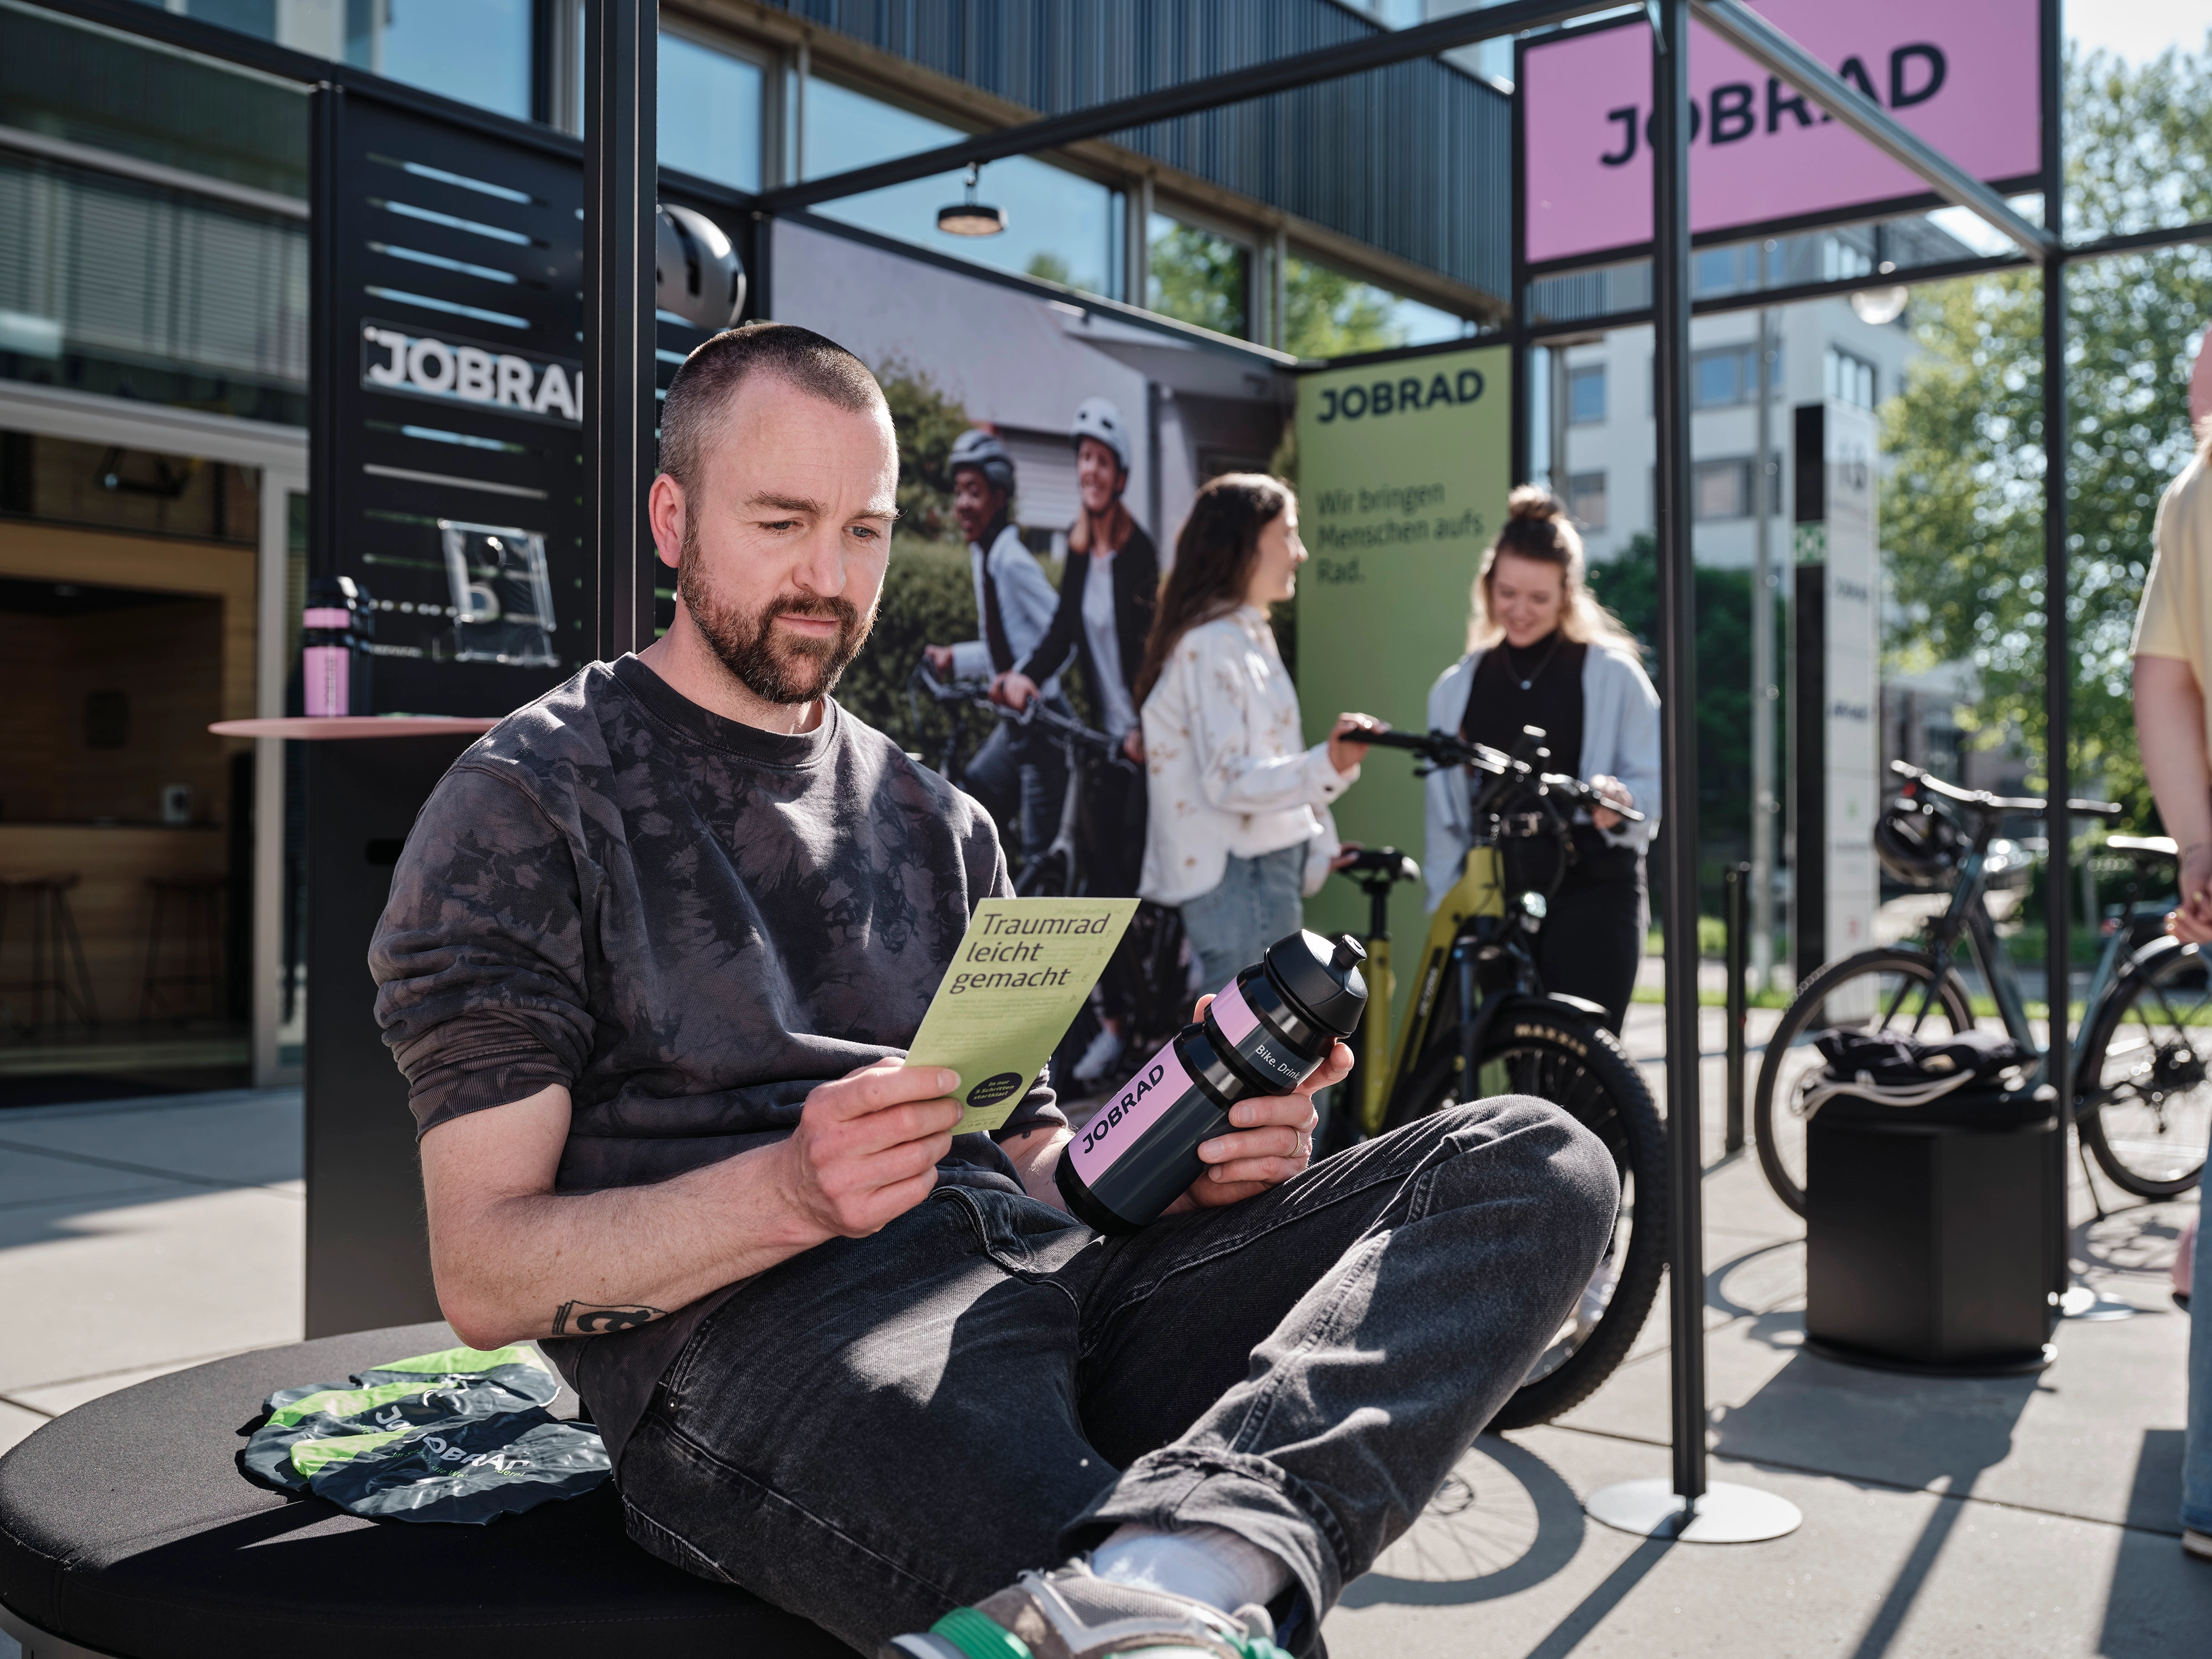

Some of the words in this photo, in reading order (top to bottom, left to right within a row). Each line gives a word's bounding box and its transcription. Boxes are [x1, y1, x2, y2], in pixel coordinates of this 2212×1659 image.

[369, 330, 583, 422] JOBRA
[1317, 369, 1485, 424] JOBRAD
[1316, 488, 1353, 517] Wir
[1358, 484, 1445, 517] bringen
[1316, 518, 1430, 550] Menschen
[1433, 509, 1485, 541] aufs
[982, 913, 1110, 935] Traumrad
[966, 941, 1044, 962] leicht
[950, 967, 1071, 994] gemacht
[1255, 1044, 1276, 1068] Bike.
[1277, 1063, 1301, 1080] Drink.
[973, 1091, 1009, 1100] startklar!
[981, 1085, 1014, 1093] Schritten
[1082, 1065, 1164, 1154] JOBRAD
[431, 1465, 447, 1474] die
